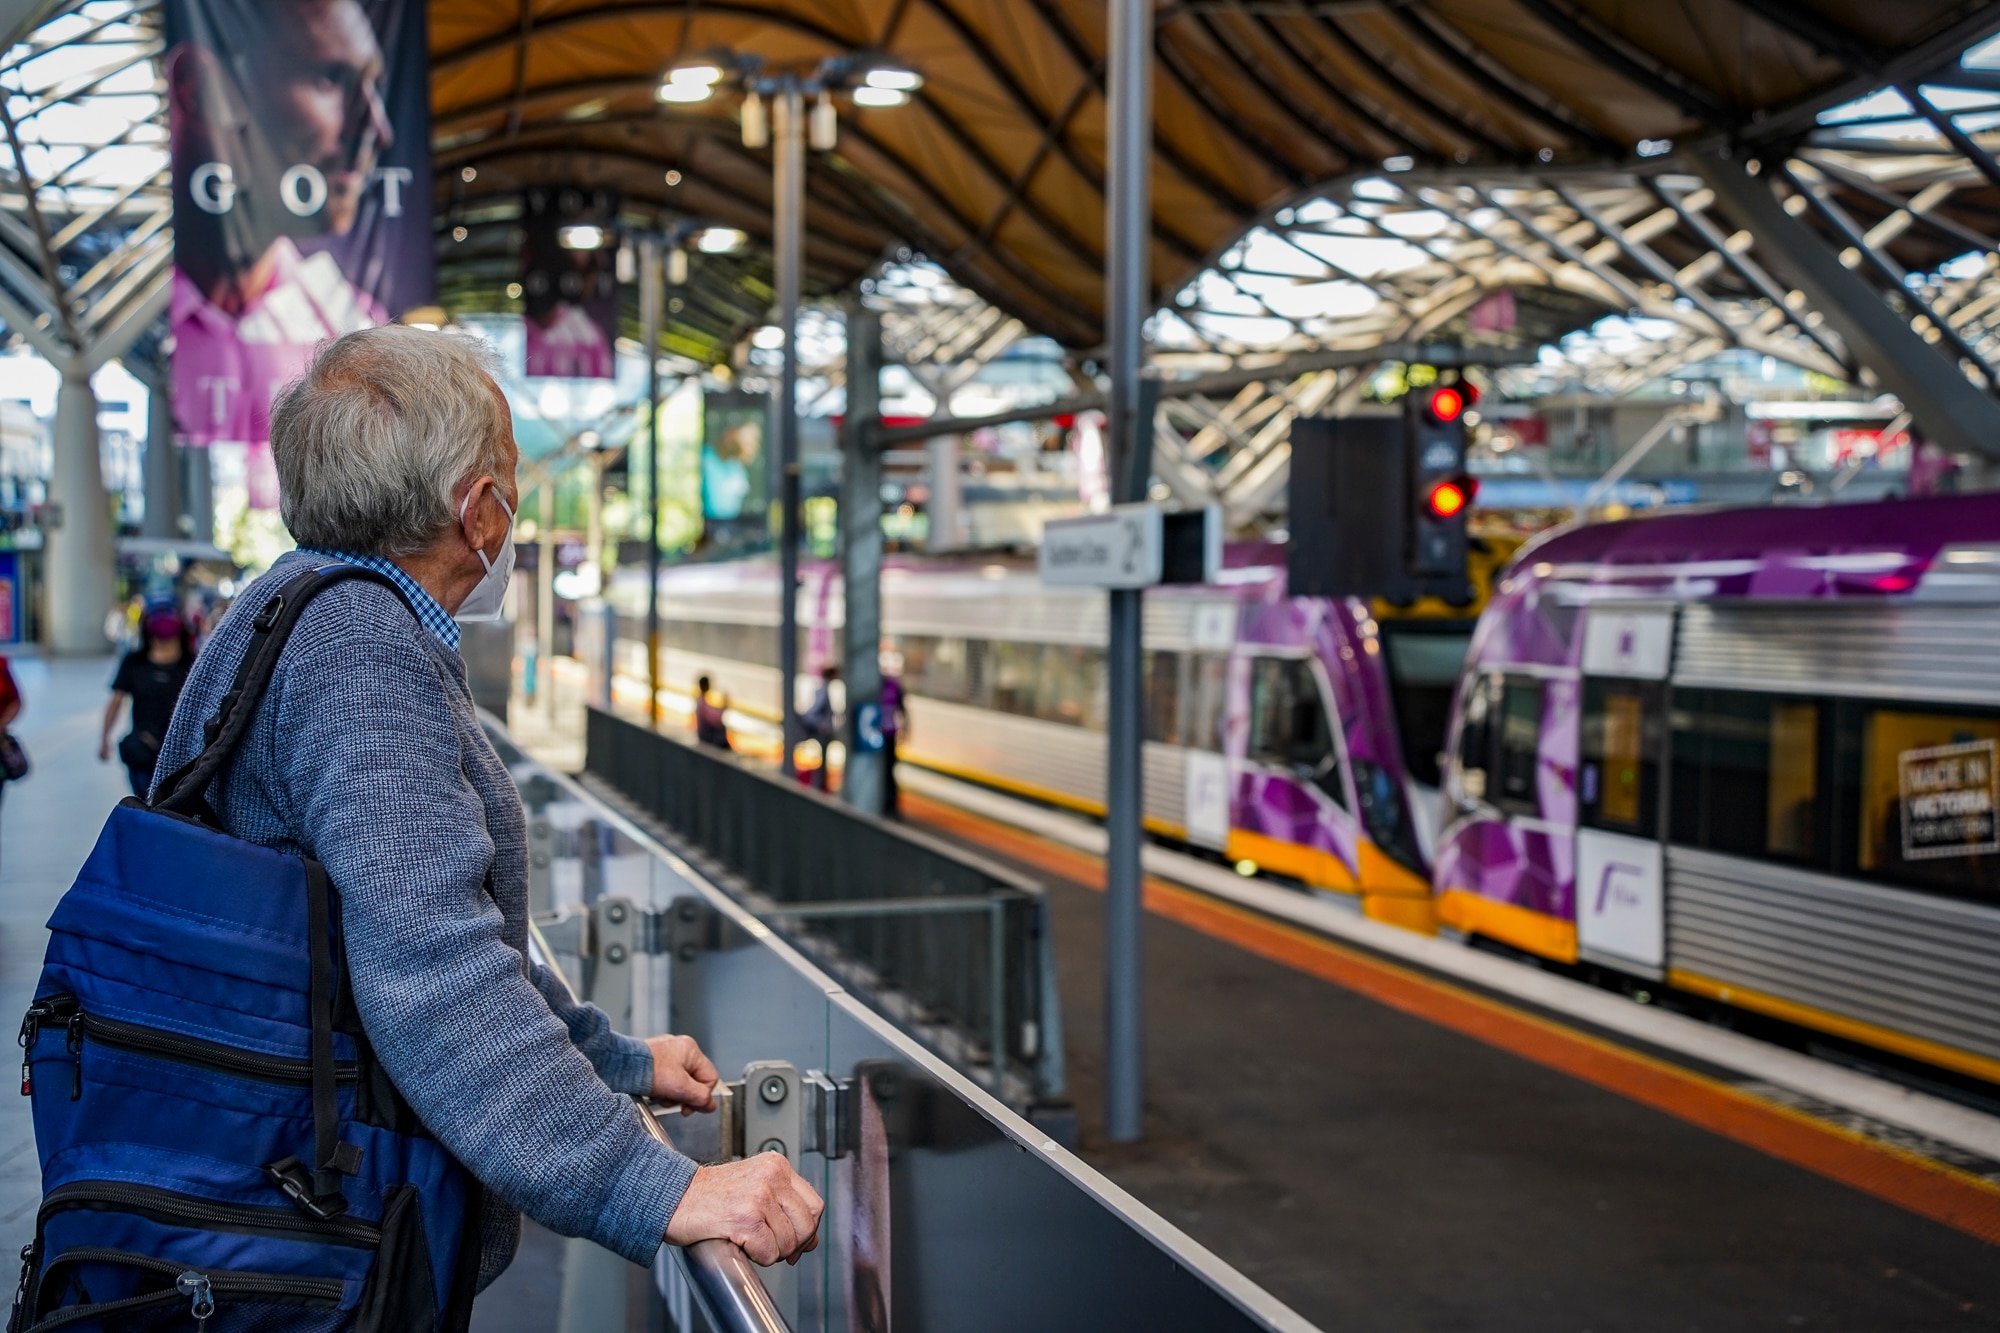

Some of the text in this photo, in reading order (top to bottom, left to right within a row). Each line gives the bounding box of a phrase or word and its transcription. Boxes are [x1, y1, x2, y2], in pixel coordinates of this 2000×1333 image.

[1909, 757, 1986, 790] MADE IN
[1909, 790, 1990, 818] VICTORIA
